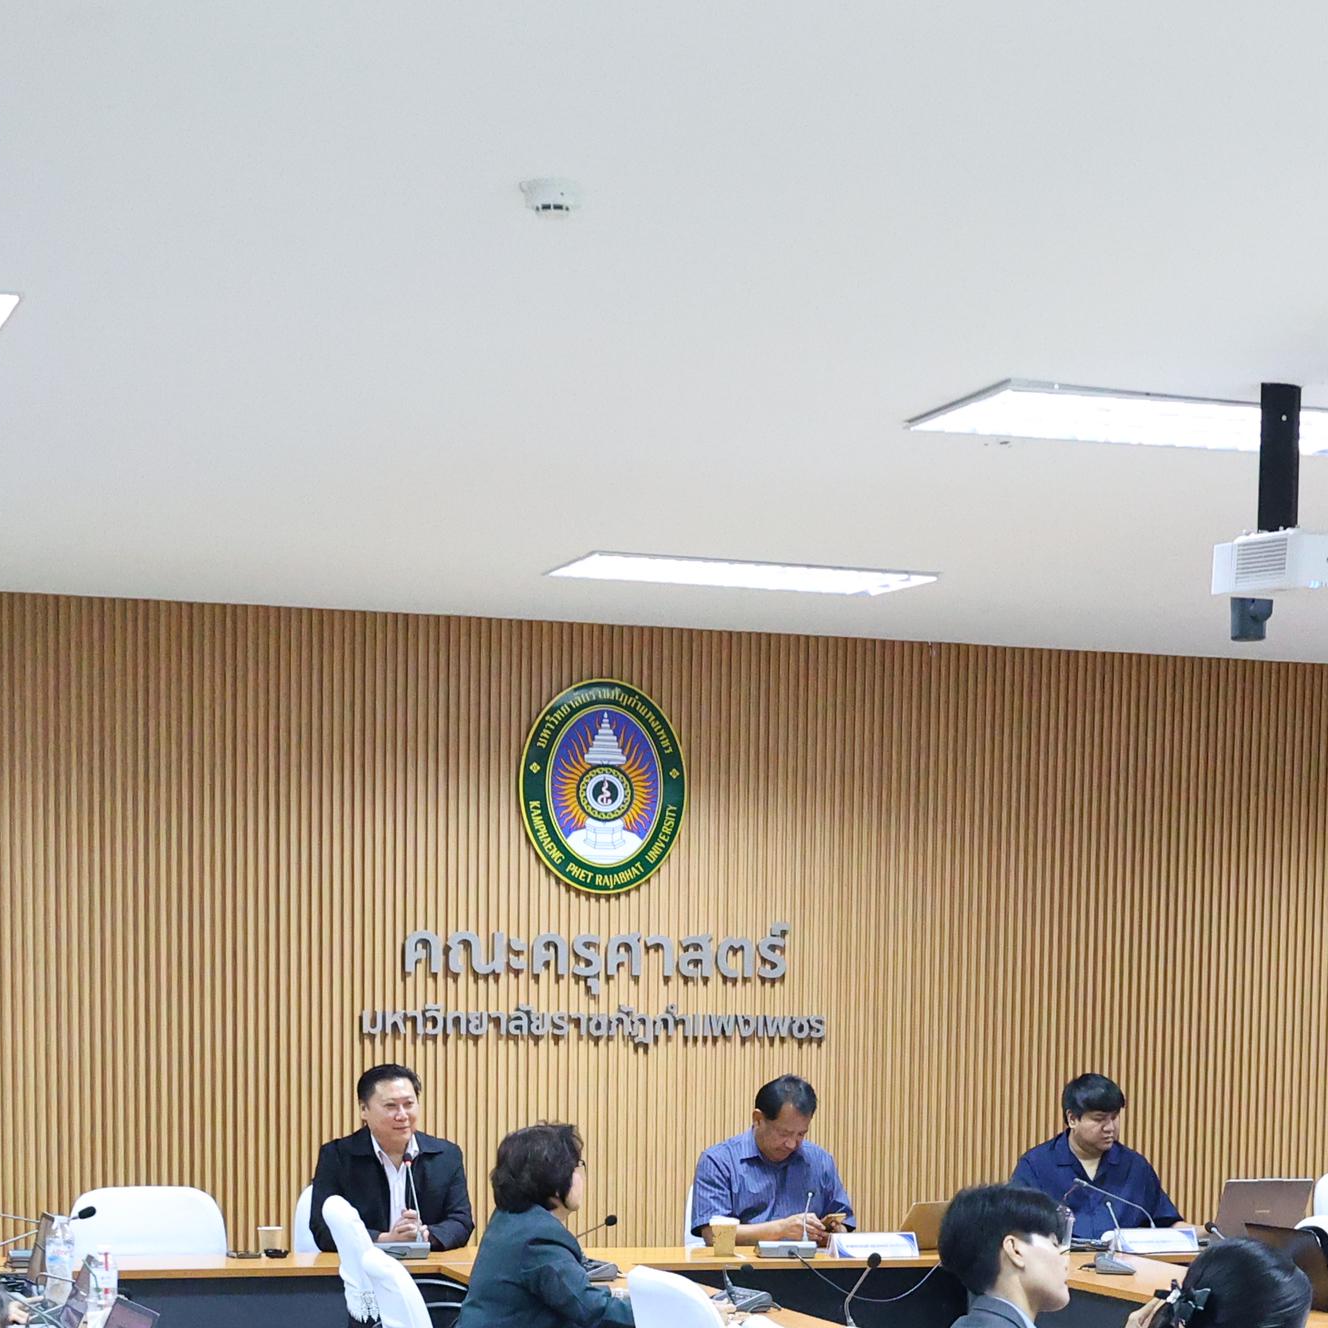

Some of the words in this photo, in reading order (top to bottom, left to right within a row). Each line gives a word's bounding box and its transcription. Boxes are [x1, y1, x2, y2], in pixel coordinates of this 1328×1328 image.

[529, 800, 565, 865] KAMPHAENG
[566, 862, 594, 883] PHET
[595, 862, 645, 888] RAJABHAT
[645, 803, 677, 865] UNIVERSITY
[404, 921, 791, 995] คณะครุศาสตร์
[362, 1001, 826, 1045] มหาวิทยาลัยราชภัฏกำแพงเพชร
